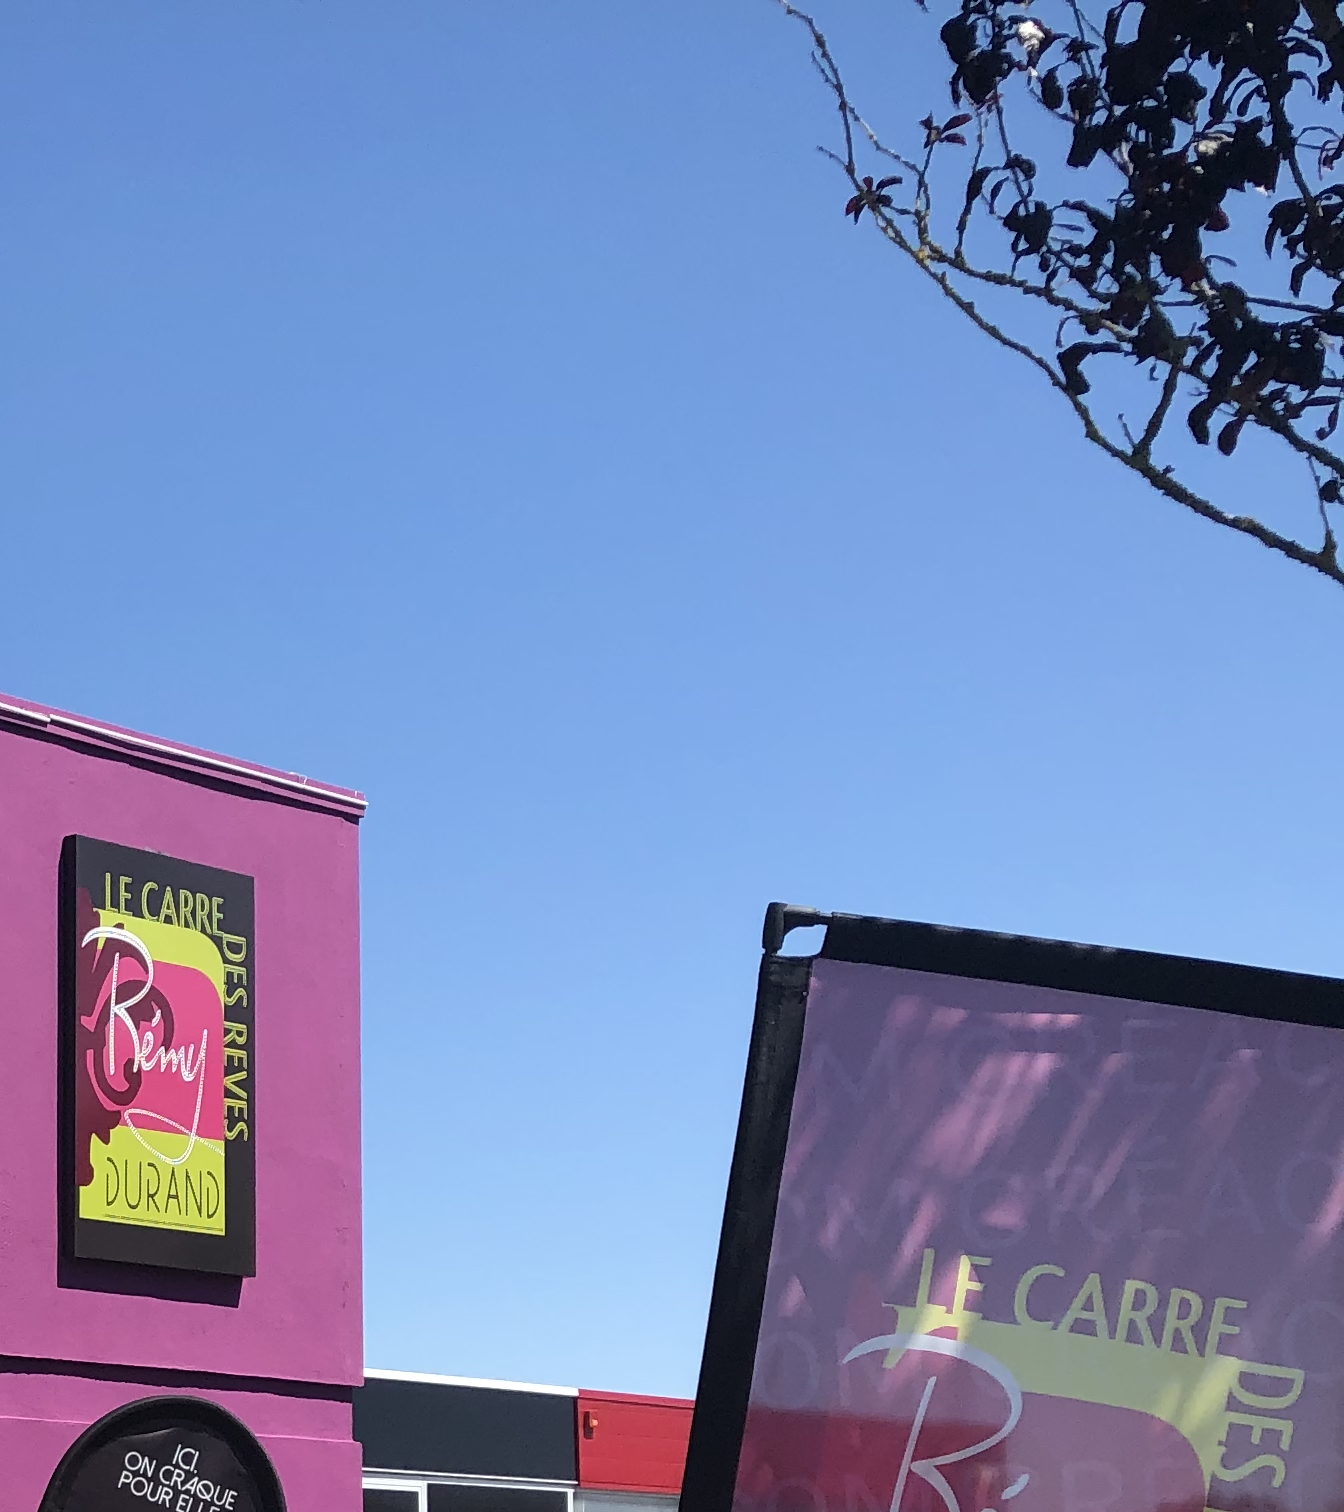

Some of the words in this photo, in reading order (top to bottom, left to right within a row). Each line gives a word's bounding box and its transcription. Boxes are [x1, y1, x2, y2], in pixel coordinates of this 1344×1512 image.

[105, 872, 133, 915] LE
[141, 881, 225, 934] CARRE
[223, 933, 247, 1008] DES
[81, 926, 225, 1165] Rémy
[223, 1021, 248, 1142] REVES
[105, 1156, 220, 1220] DURAND
[914, 1247, 993, 1332] LE
[1014, 1264, 1248, 1358] CARRE
[1219, 1361, 1305, 1491] DES
[118, 1471, 173, 1508] POUR
[125, 1452, 156, 1477] ON
[159, 1465, 238, 1510] CRAQUE
